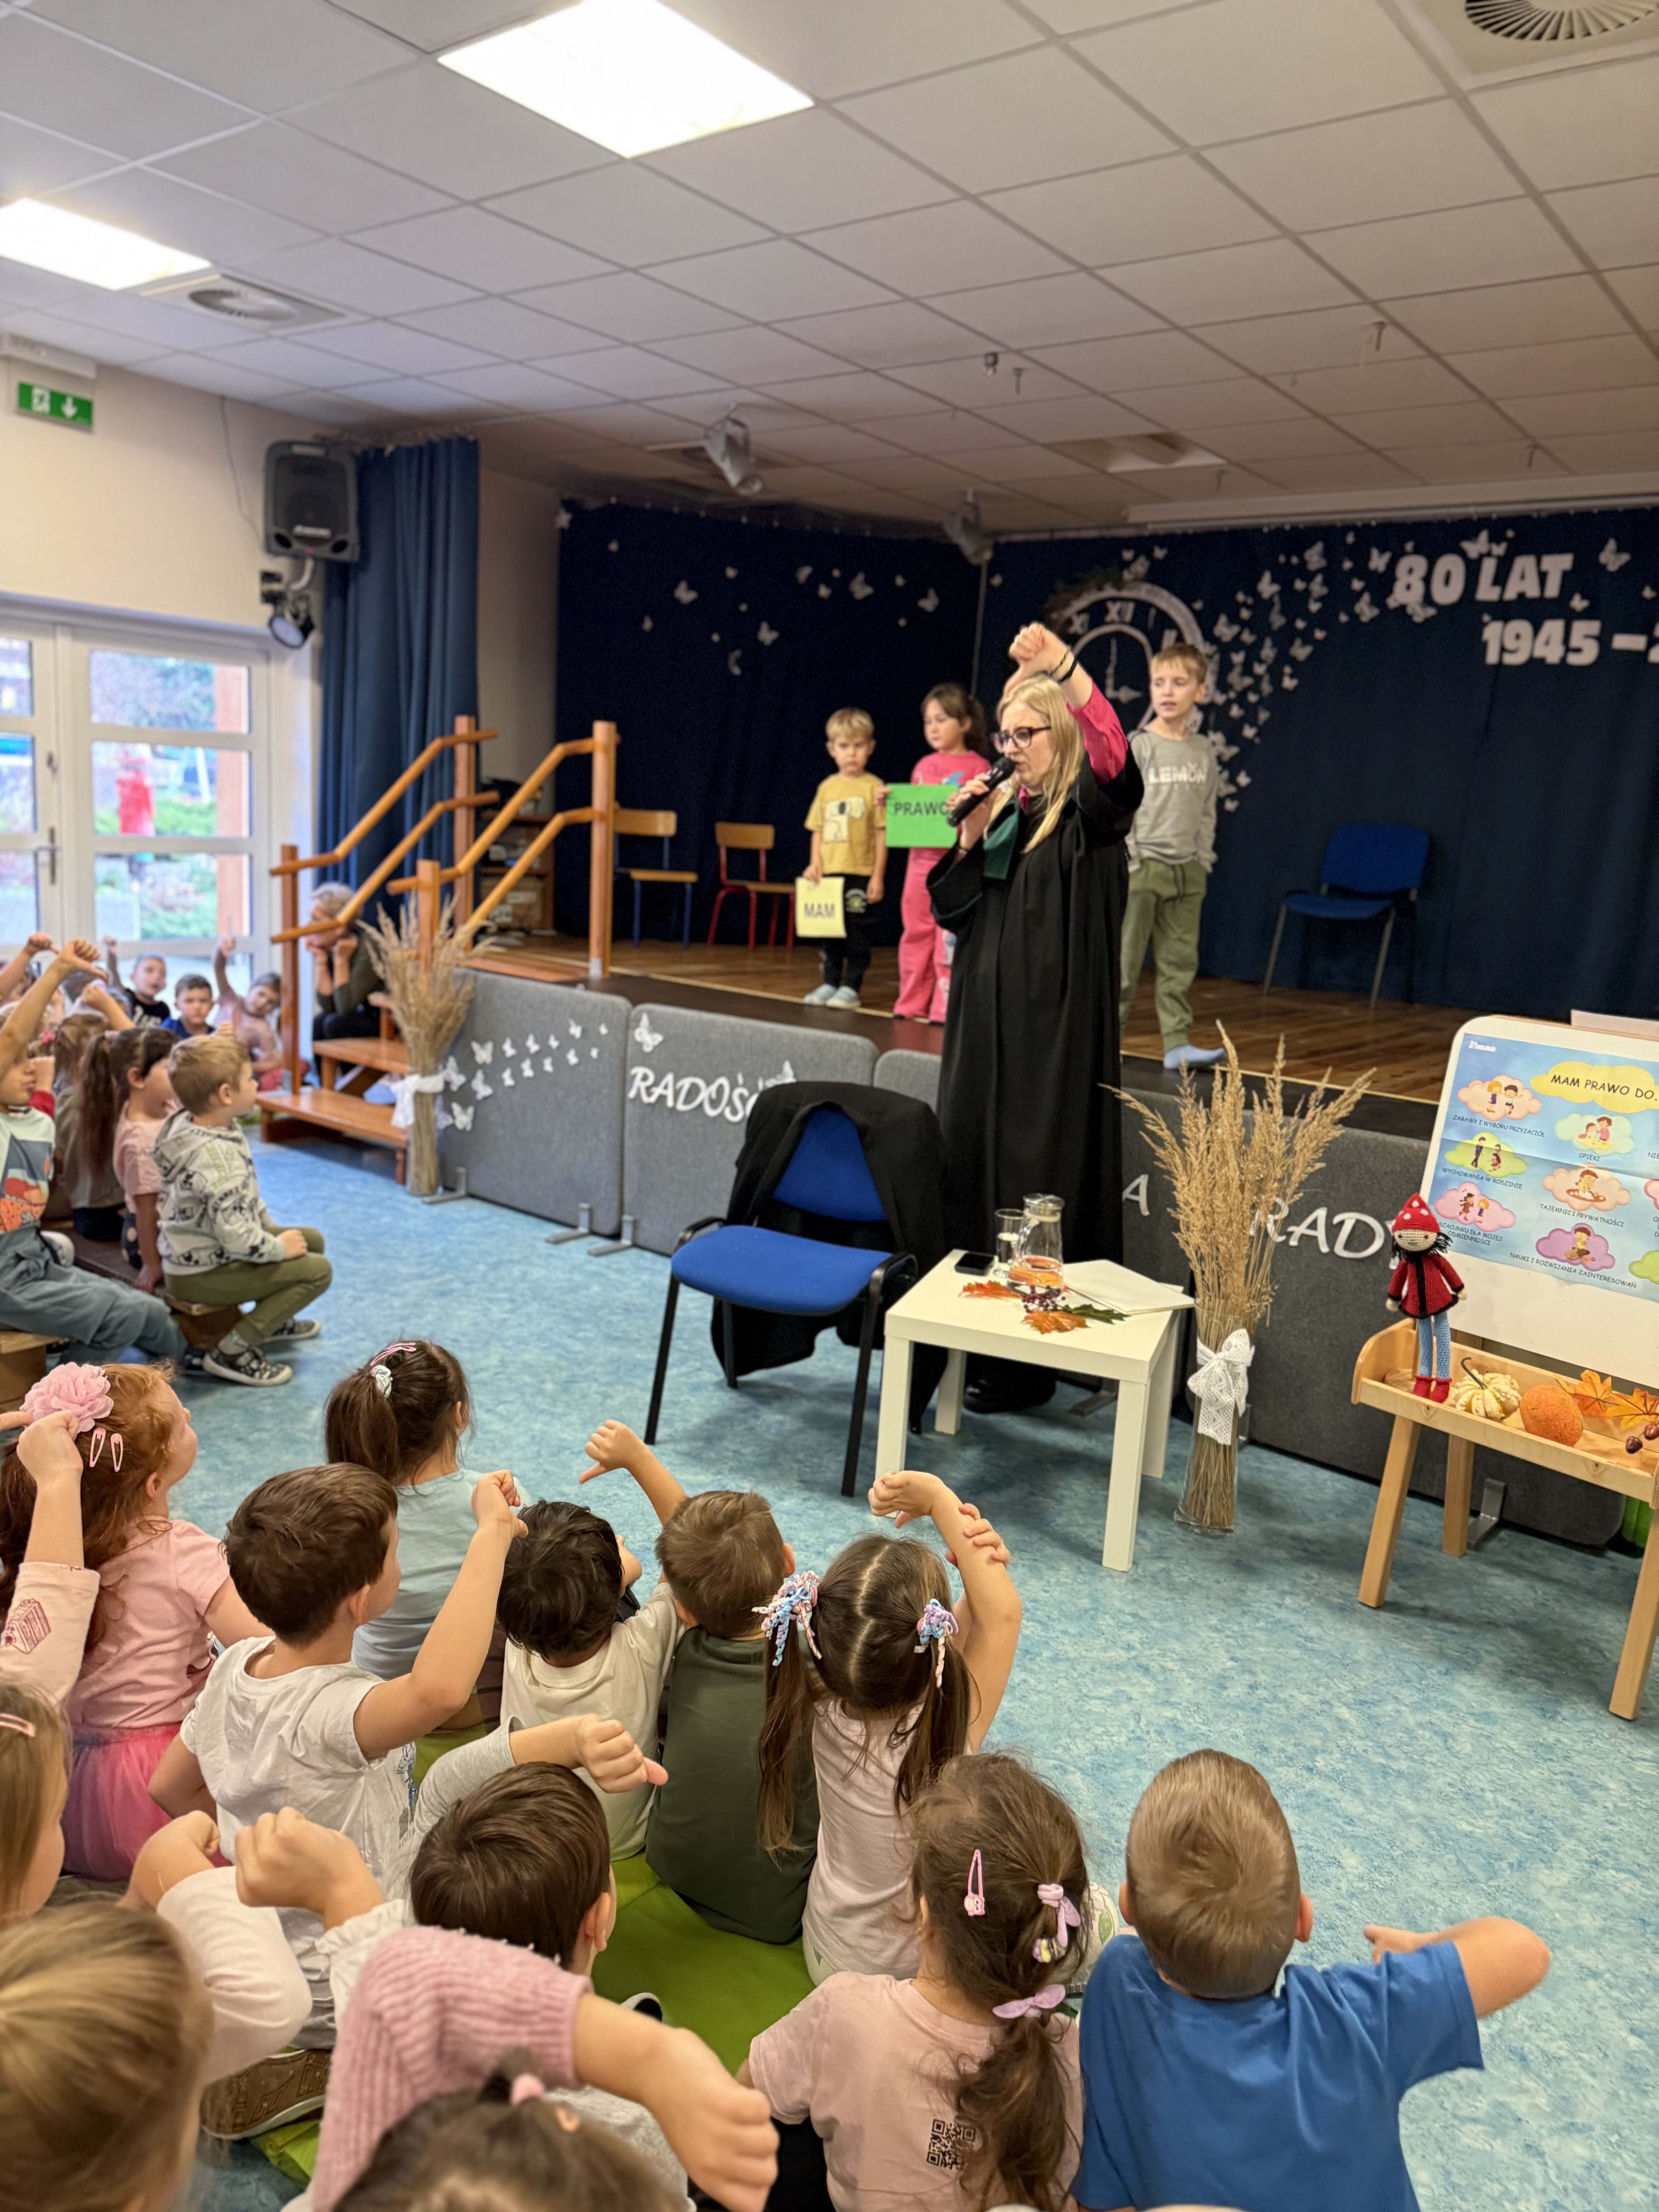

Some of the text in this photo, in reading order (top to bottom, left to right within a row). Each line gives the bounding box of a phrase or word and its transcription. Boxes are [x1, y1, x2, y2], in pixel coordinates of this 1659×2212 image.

[1394, 553, 1574, 605] 80 LAT
[1482, 619, 1602, 666] 1945
[804, 903, 836, 919] MAM
[1551, 1074, 1580, 1087] MAM
[1584, 1079, 1630, 1095] PRAWO
[1453, 1115, 1477, 1123] ZABAWY
[1484, 1121, 1508, 1130] WYBORU
[1509, 1126, 1545, 1137] PRZYJACIÓŁ
[1578, 1152, 1601, 1161] OPIEKI
[1443, 1167, 1484, 1180] WYCHOWANIA
[1492, 1178, 1523, 1190] RODZINIE
[1540, 1203, 1571, 1215] TAJEMNIC
[1576, 1212, 1625, 1227] PRYWATNOŚCI
[1249, 1196, 1399, 1269] RAD
[1439, 1222, 1469, 1233] SZACUNKU
[1482, 1232, 1504, 1242] MOJEJ
[1448, 1230, 1491, 1245] ODMIENNOŚCI
[1510, 1252, 1530, 1262] NAUKI
[1535, 1259, 1577, 1274] ROZWIJANIA
[1578, 1269, 1636, 1289] ZAINTERESOWAŃ
